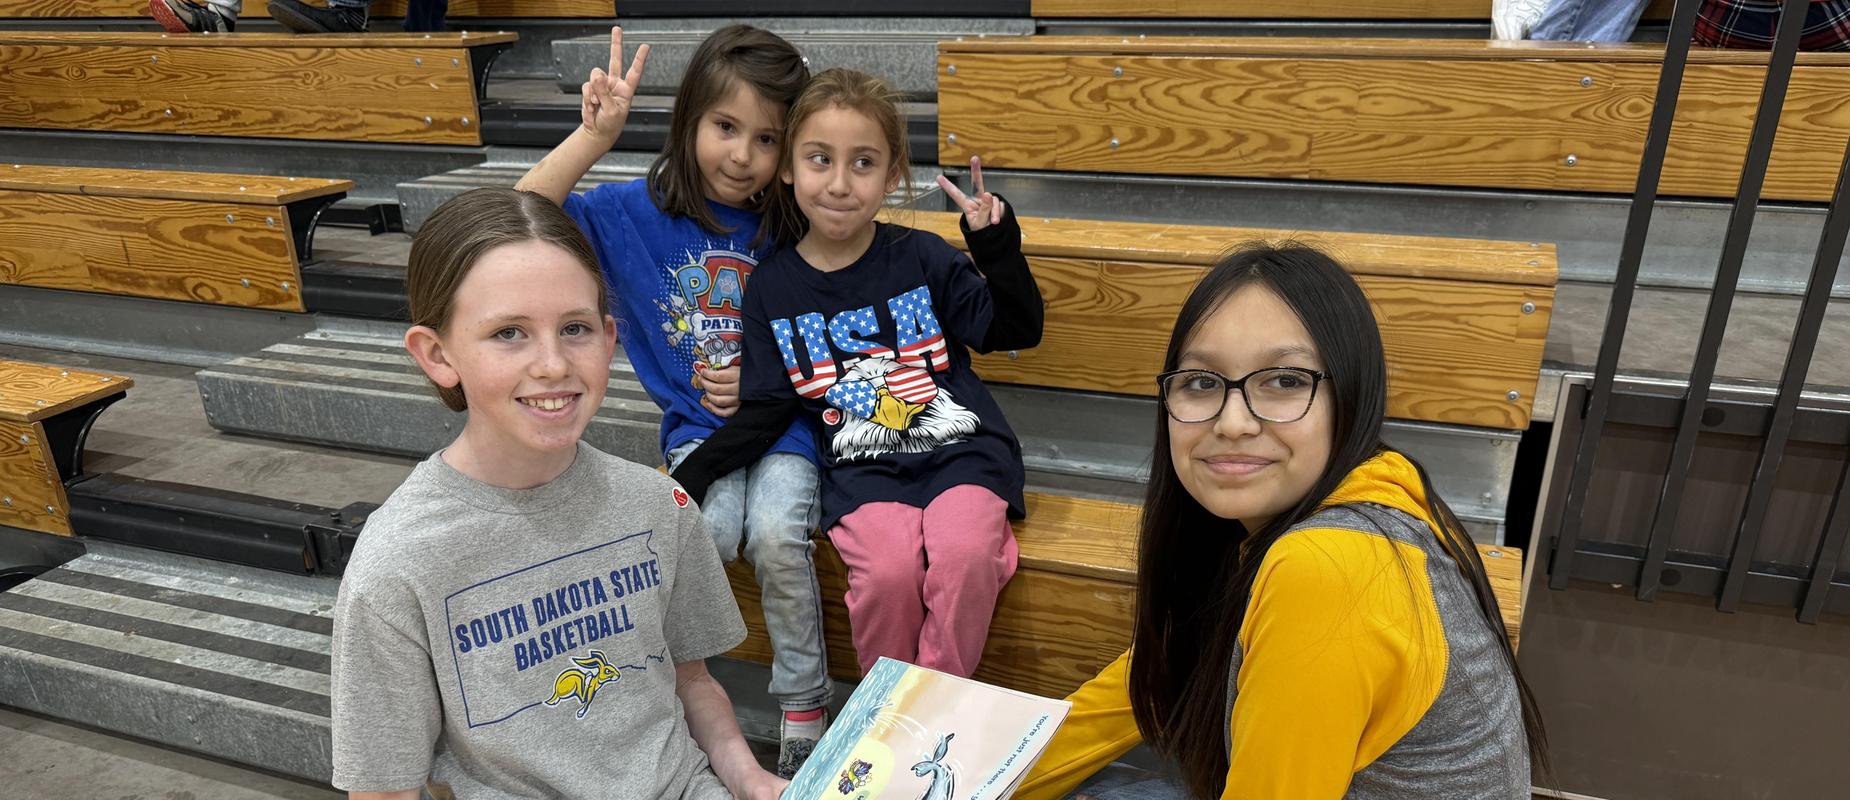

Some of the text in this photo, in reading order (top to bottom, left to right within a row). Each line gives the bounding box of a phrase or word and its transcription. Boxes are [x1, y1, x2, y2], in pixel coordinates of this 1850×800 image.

[675, 264, 750, 311] PA
[770, 286, 950, 400] USA
[455, 559, 661, 653] SOUTH DAKOTA STATE
[513, 604, 635, 672] BASKETBALL
[1004, 753, 1017, 767] not
[1016, 737, 1031, 753] just
[987, 767, 1006, 785] there
